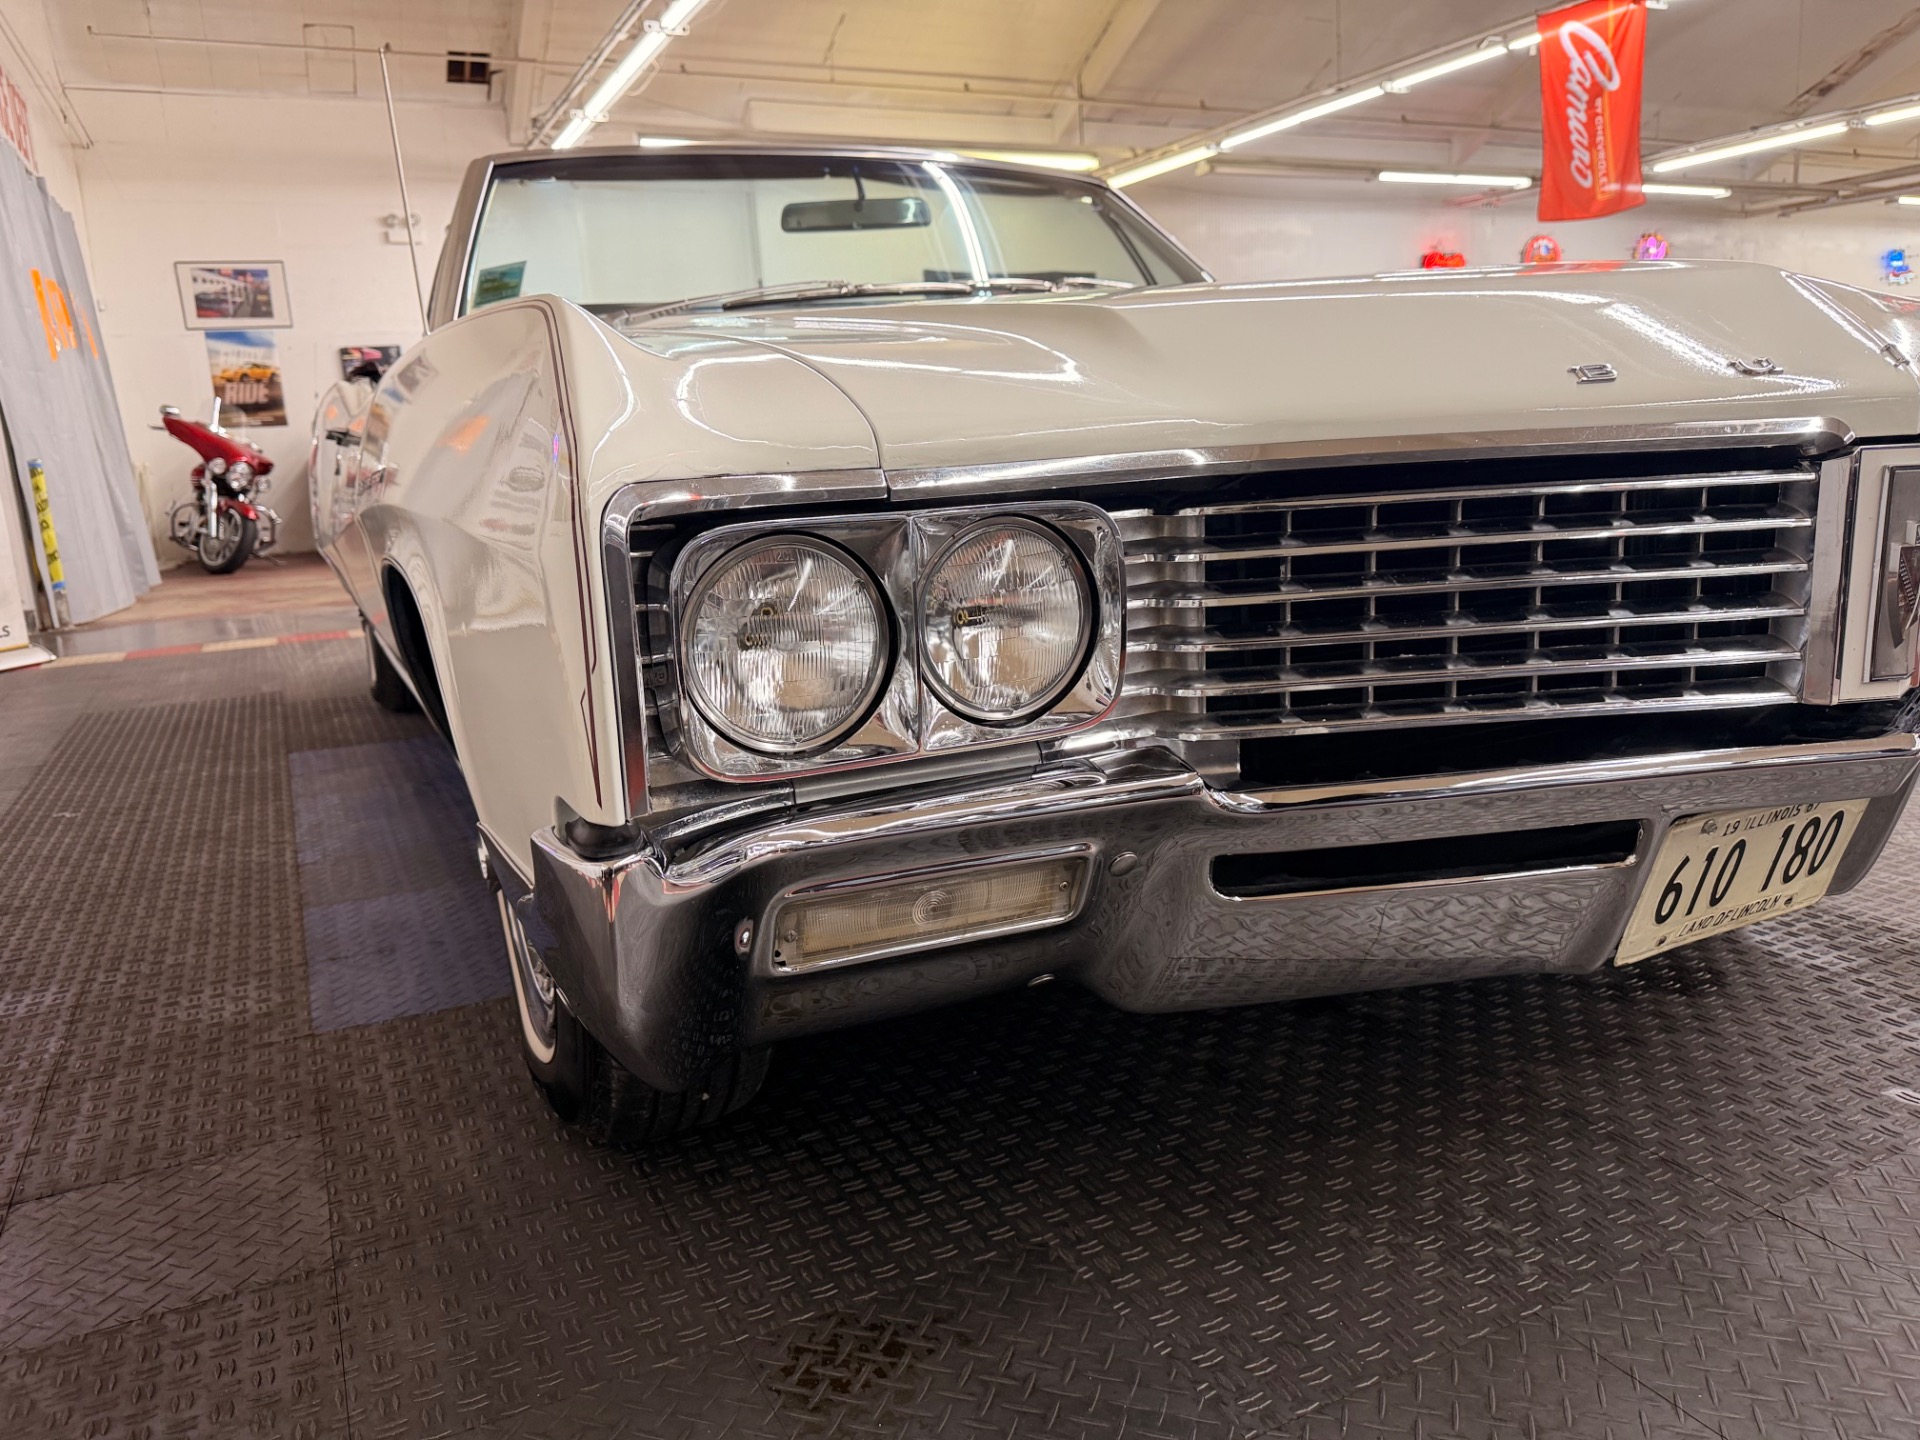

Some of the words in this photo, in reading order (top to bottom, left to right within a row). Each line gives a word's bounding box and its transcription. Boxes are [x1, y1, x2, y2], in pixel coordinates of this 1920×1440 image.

[1721, 819, 1741, 837] 19
[1744, 803, 1802, 831] ILLINOIS
[1654, 838, 1747, 925] 610
[1761, 809, 1845, 892] 180
[1677, 913, 1715, 937] LAND
[1713, 909, 1735, 927] OF
[1730, 894, 1783, 922] LINCOLN
